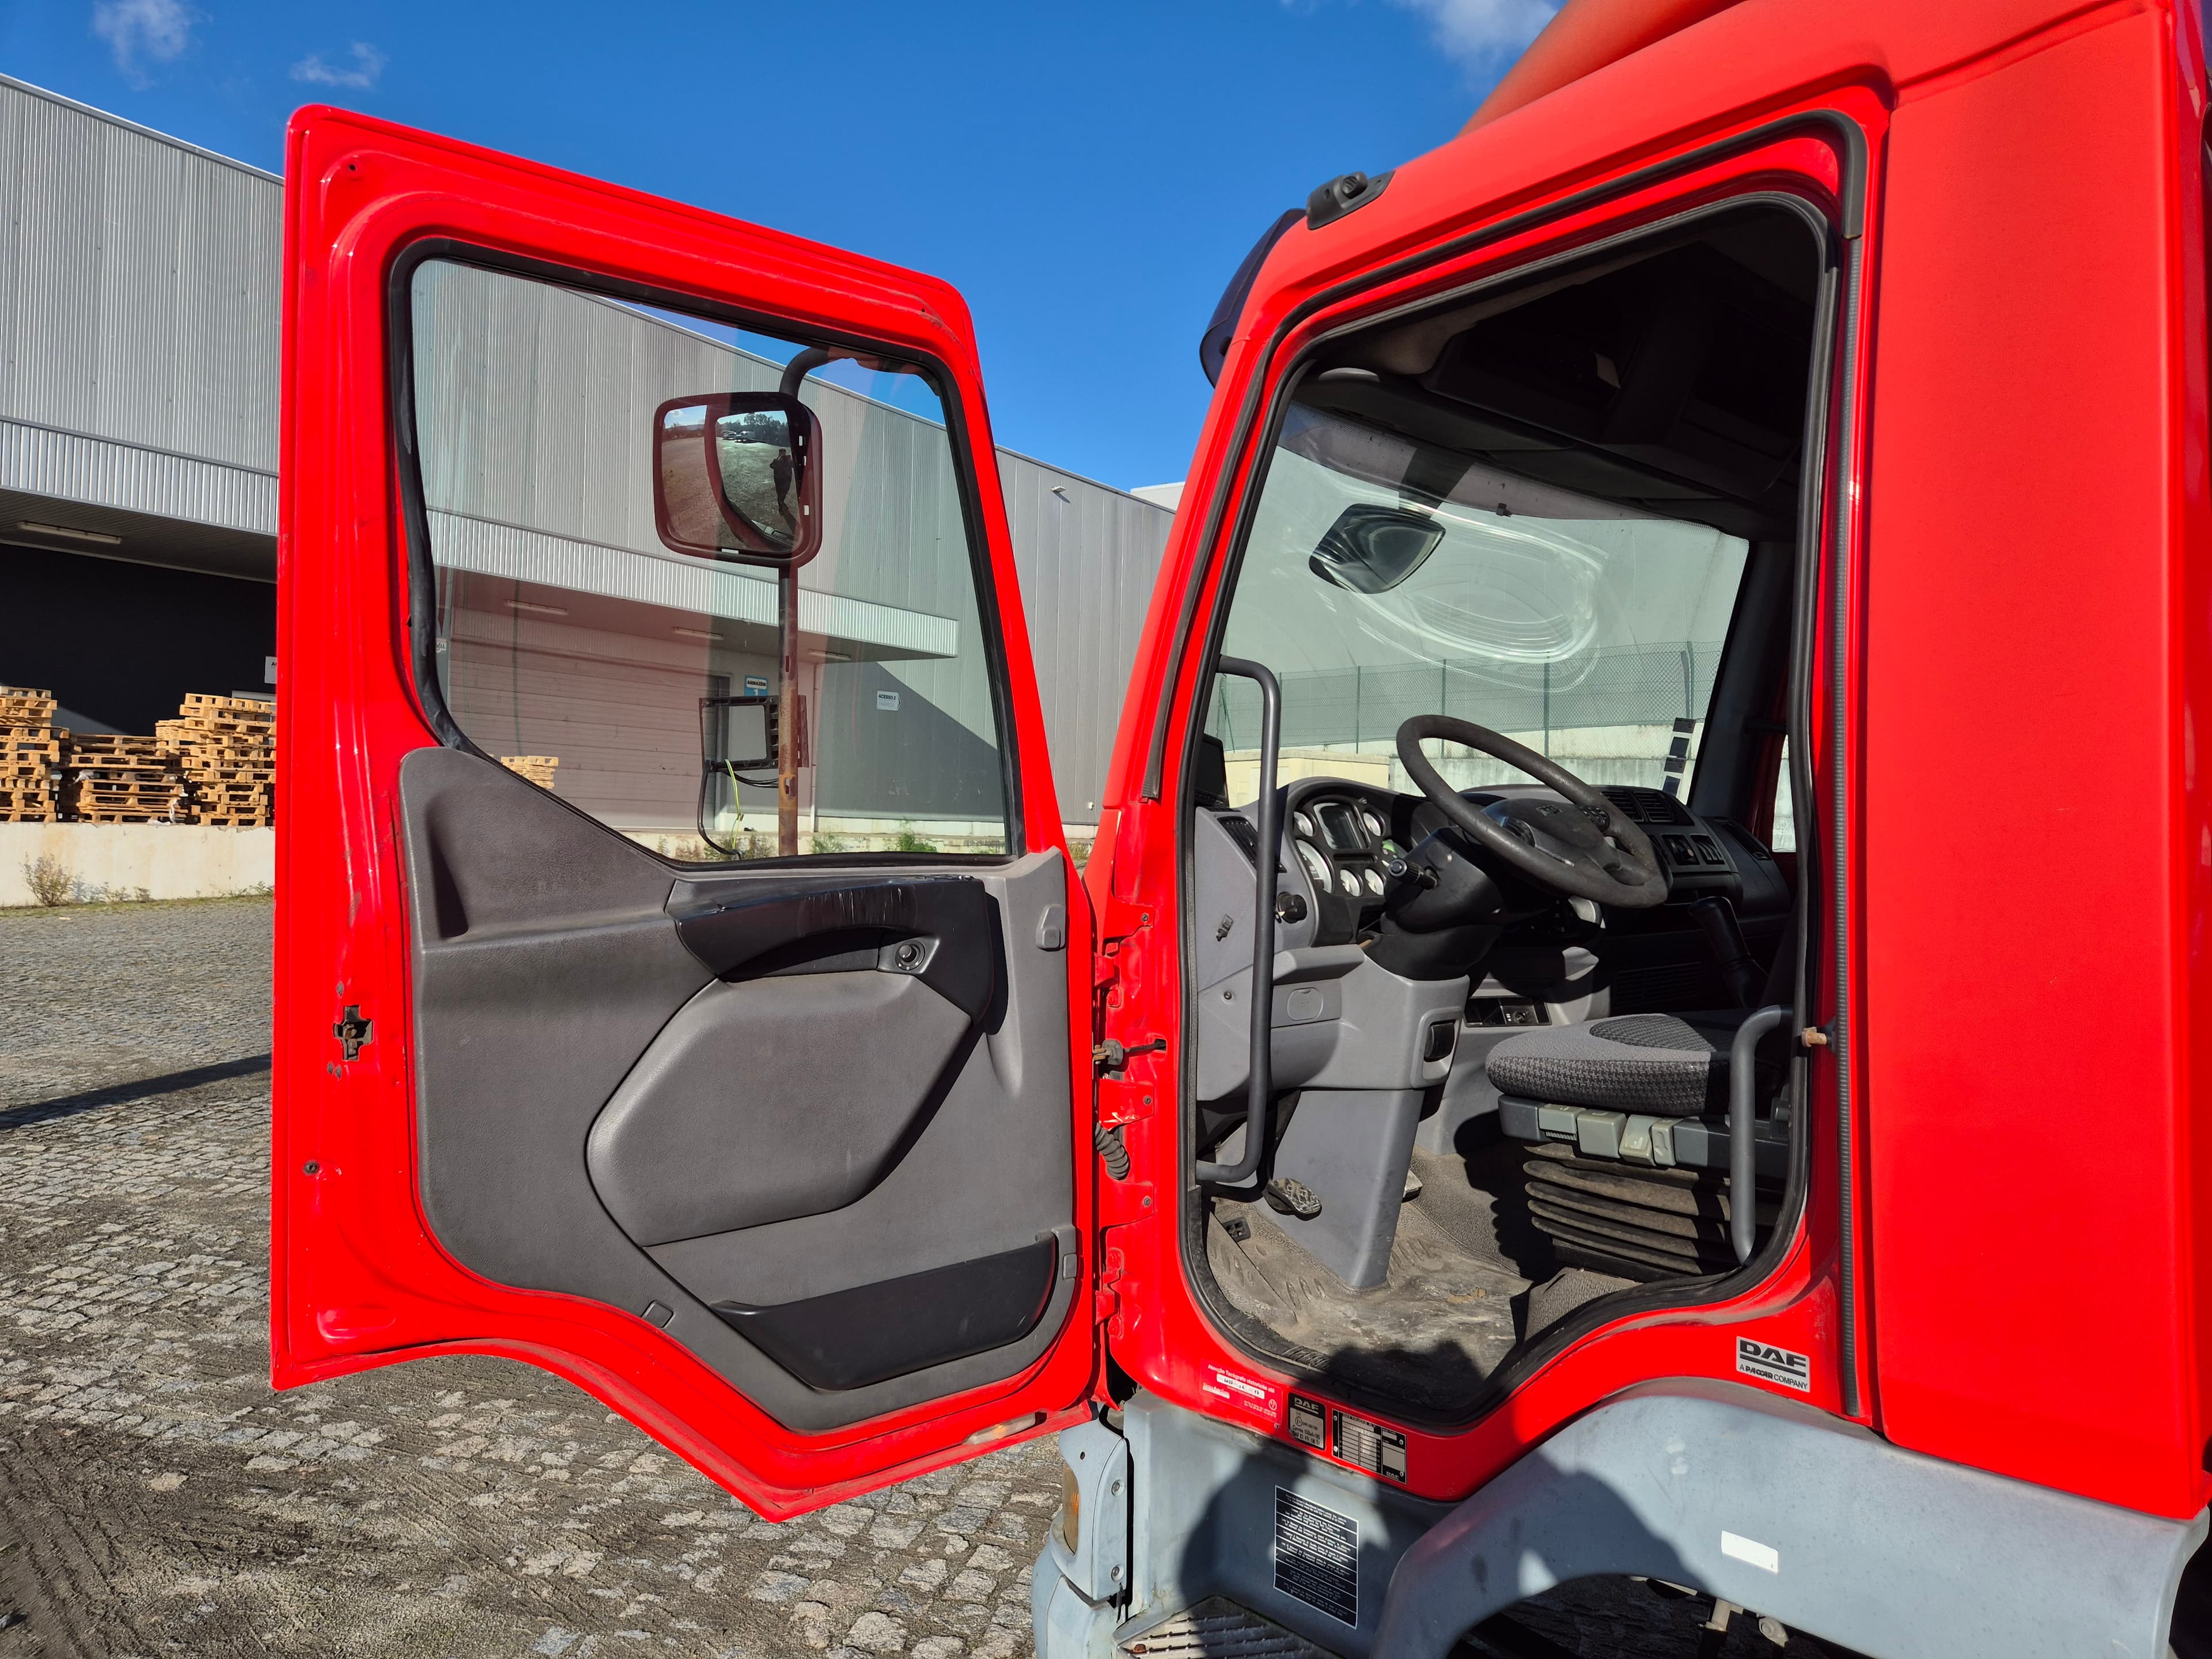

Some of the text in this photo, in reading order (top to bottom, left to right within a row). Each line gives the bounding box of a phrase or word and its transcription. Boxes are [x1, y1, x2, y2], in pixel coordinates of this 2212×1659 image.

[1740, 1339, 1806, 1368] DAF
[1745, 1366, 1773, 1380] PACCAR
[1774, 1373, 1808, 1389] COMPANY
[1294, 1397, 1319, 1411] DAF
